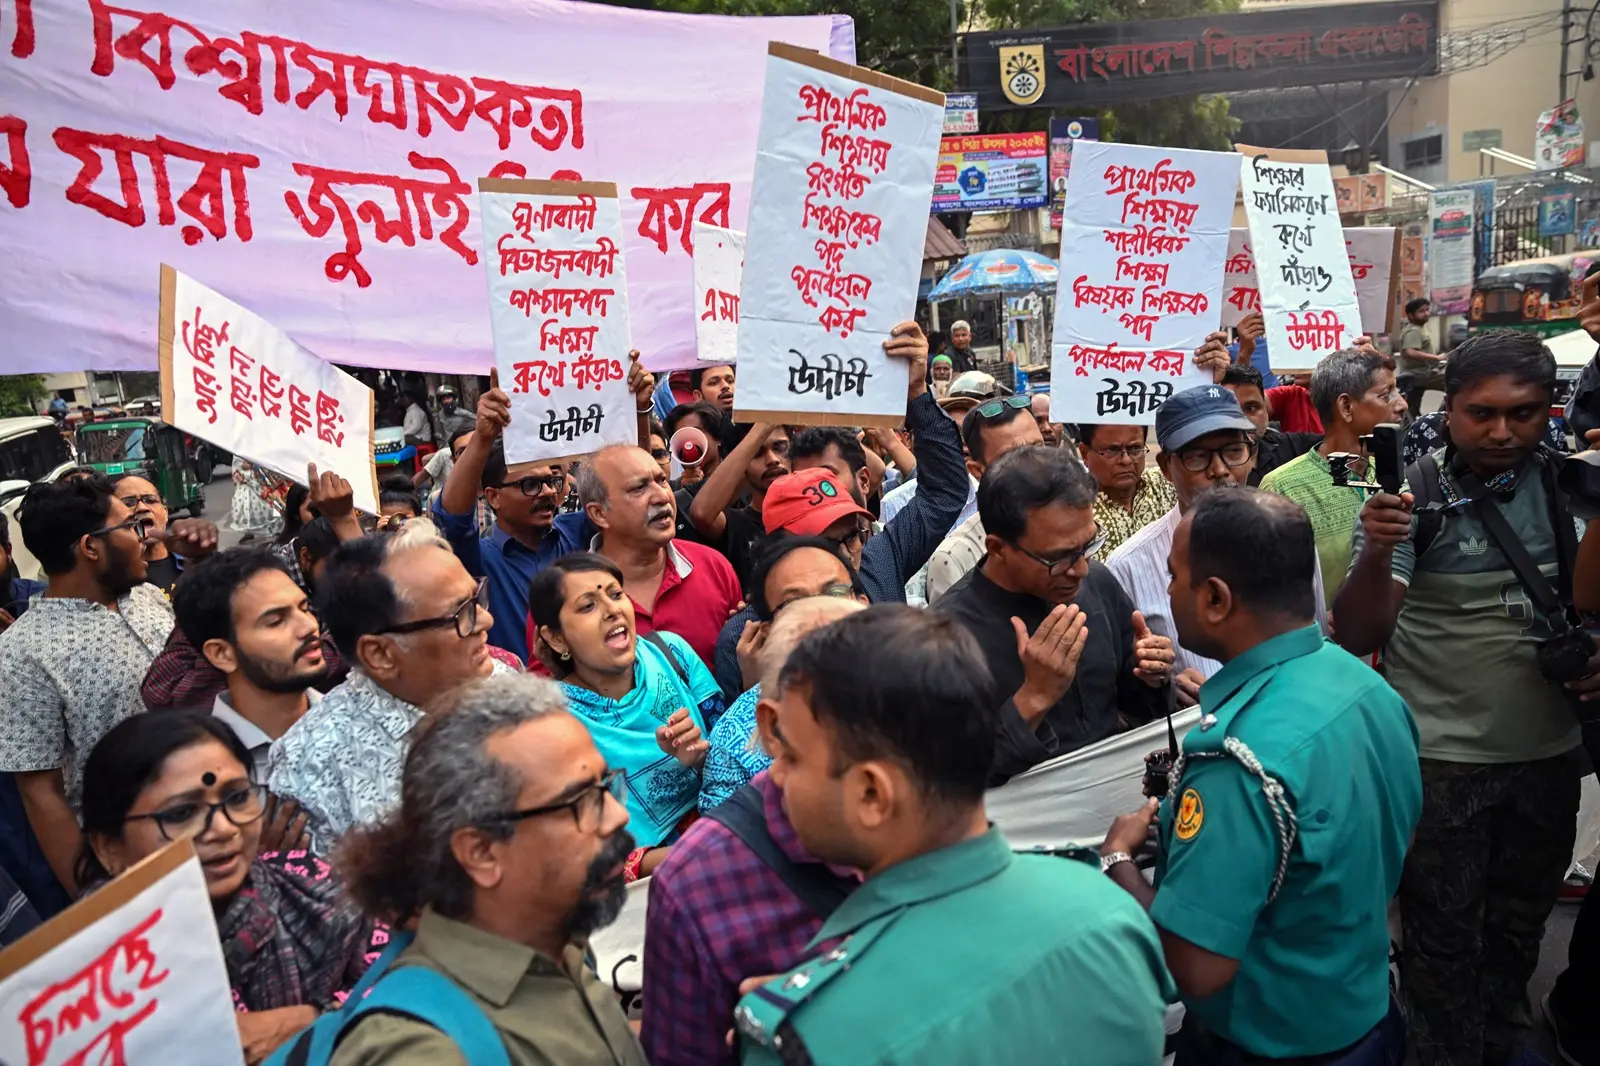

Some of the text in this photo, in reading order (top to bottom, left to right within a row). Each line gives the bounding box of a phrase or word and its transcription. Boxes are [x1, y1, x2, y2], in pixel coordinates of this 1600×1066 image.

[88, 1, 584, 151] বিশ্বাসঘাতকতা
[1054, 36, 1200, 83] বাংলাদেশ
[1203, 27, 1313, 71] শিল্পকলা
[797, 84, 887, 131] প্রাথমিক
[820, 123, 892, 175] শিক্ষায়
[806, 162, 872, 200] সংগীত
[1103, 159, 1196, 196] প্রাথমিক
[1252, 153, 1305, 191] শিক্ষার
[52, 127, 260, 246] যারা
[284, 151, 479, 289] জুলাই
[512, 193, 597, 243] ঘৃণাবাদী
[802, 191, 882, 249] শিক্ষকের
[1121, 192, 1199, 234] শিক্ষায়
[1252, 186, 1329, 221] ফ্যাসিকরণ
[497, 233, 619, 279] বিভাজনবাদী
[815, 238, 846, 273] পদ
[1103, 224, 1190, 257] শারীরিক
[1273, 223, 1316, 254] রুখে
[1115, 255, 1170, 286] শিক্ষা
[1280, 254, 1333, 293] দাঁড়াও
[1073, 275, 1209, 315] বিষয়ক শিক্ষক
[539, 318, 599, 354] শিক্ষা
[818, 305, 867, 339] কর
[1119, 313, 1160, 342] পদ
[1285, 309, 1345, 351] উদীচী
[182, 306, 230, 425] আর কিছু
[229, 345, 257, 421] চায় না
[512, 352, 625, 397] রুখে দাঁড়াও
[788, 348, 873, 401] উদীচী
[1147, 350, 1185, 377] কর
[259, 365, 285, 418] মনে
[288, 383, 313, 436] গান
[315, 390, 345, 448] ছাড়া
[539, 403, 605, 442] উদীচী
[1484, 469, 1515, 488] GoPro
